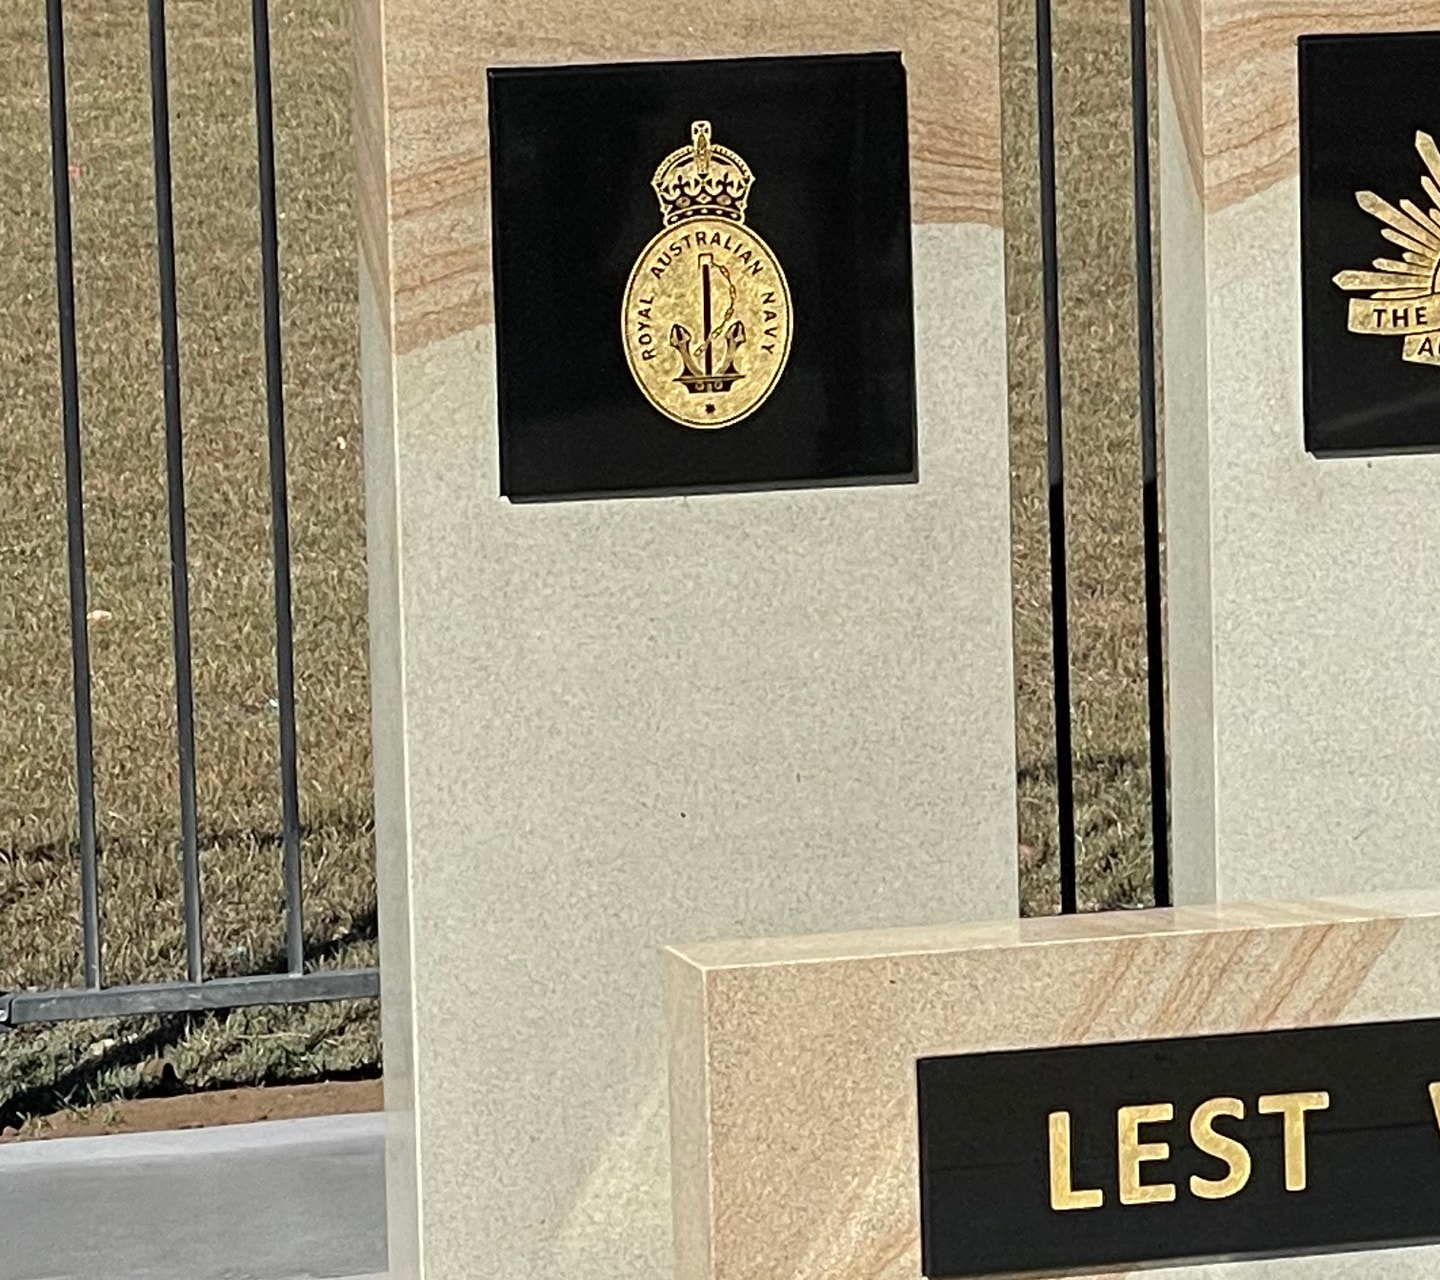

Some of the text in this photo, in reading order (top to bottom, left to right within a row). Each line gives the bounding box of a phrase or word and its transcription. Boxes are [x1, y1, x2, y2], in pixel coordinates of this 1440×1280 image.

[638, 231, 778, 361] ROYAL AUSTRALIAN NAVY
[1373, 306, 1429, 328] THE
[1047, 1090, 1331, 1212] LEST
